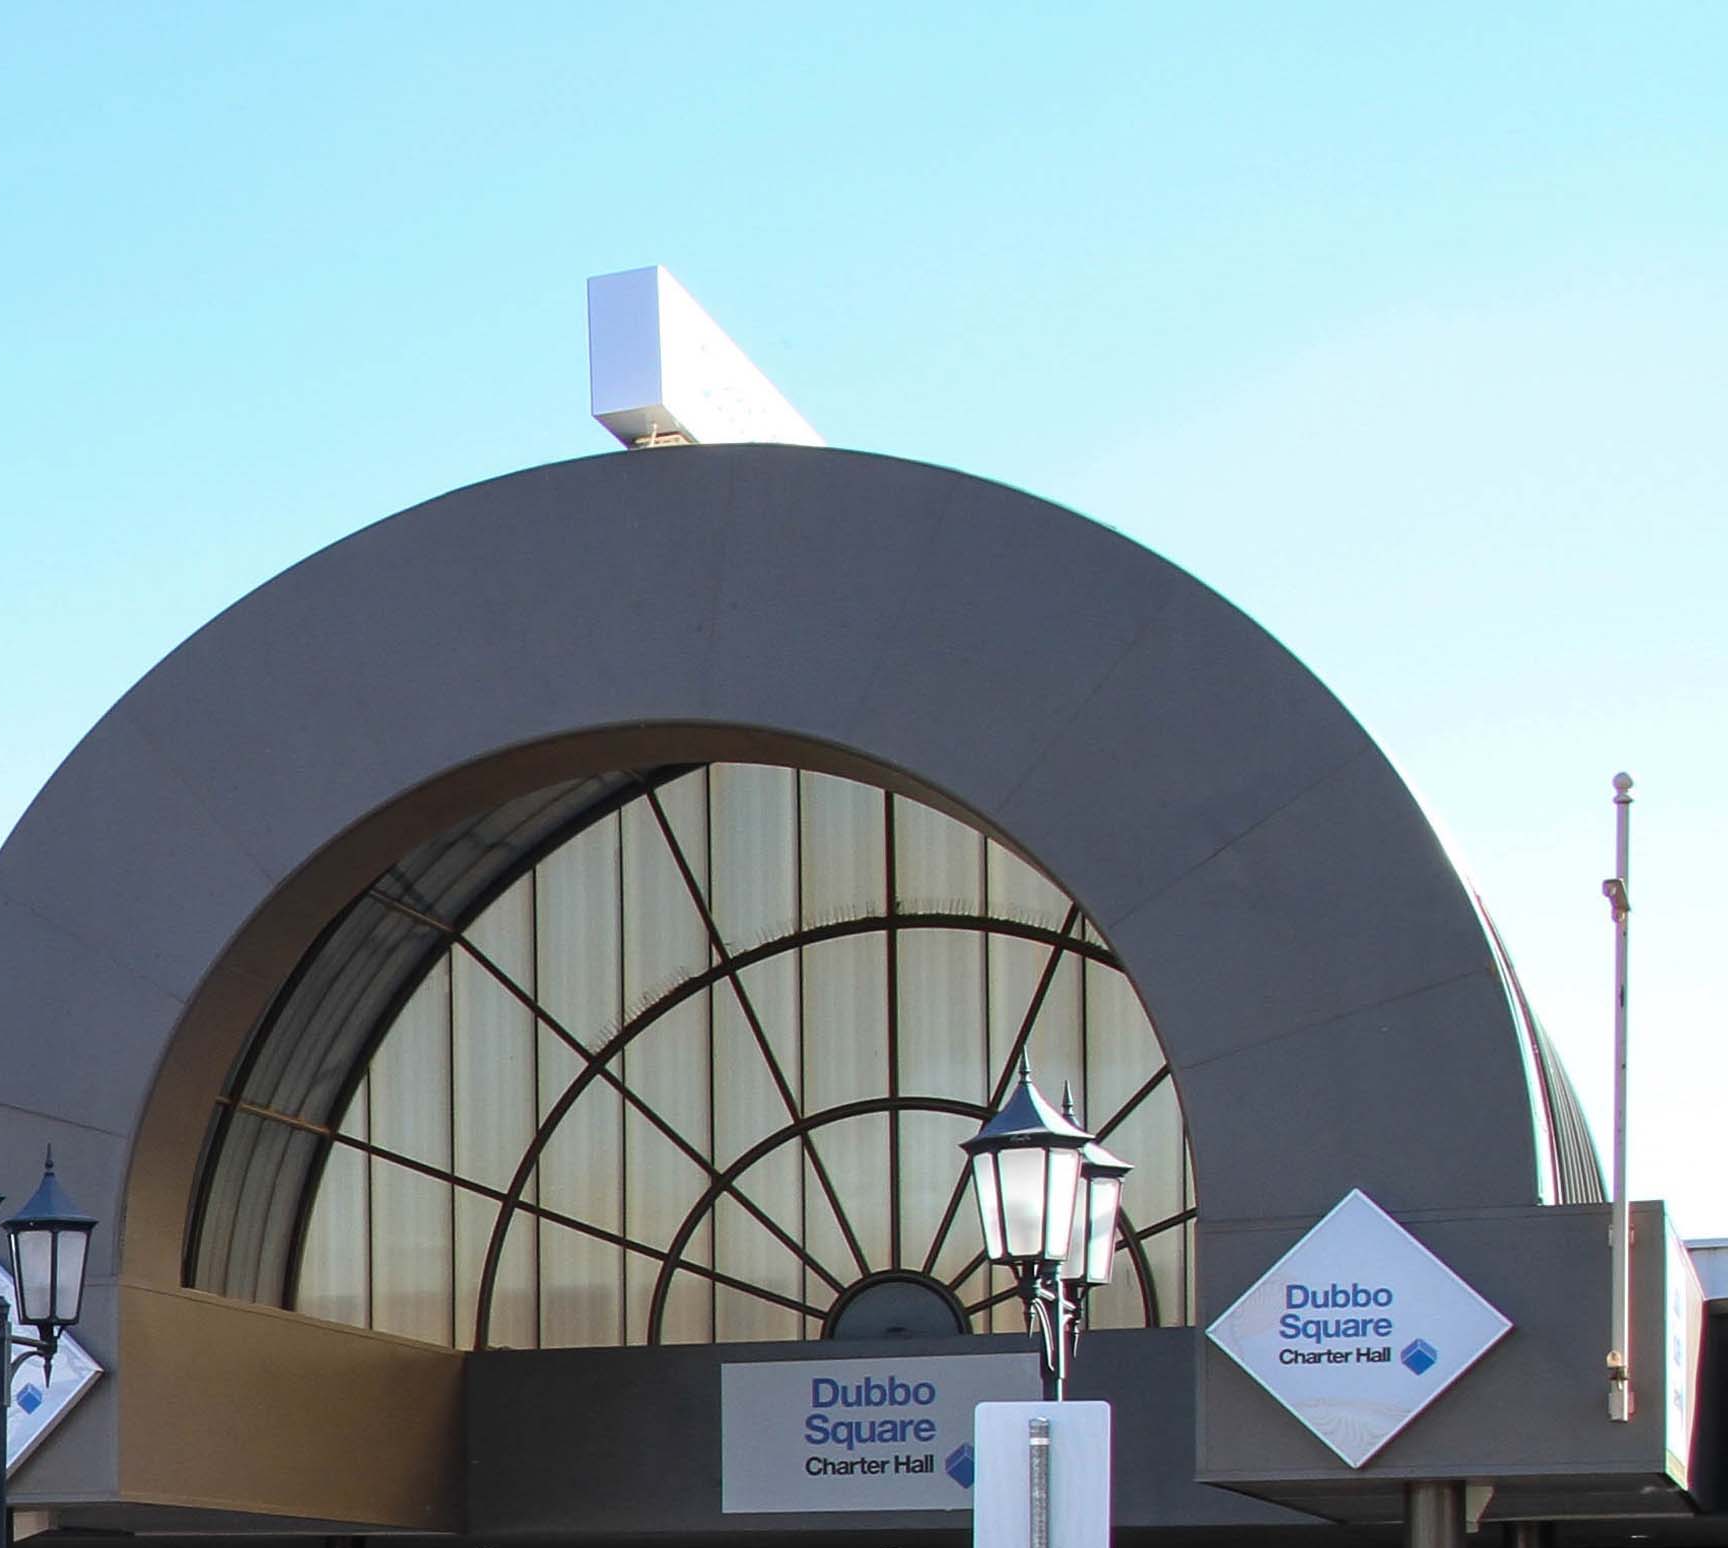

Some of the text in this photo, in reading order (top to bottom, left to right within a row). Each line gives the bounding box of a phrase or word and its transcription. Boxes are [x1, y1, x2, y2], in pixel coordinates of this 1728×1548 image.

[1286, 1283, 1393, 1310] Dubbo
[1279, 1313, 1393, 1345] Square
[1279, 1347, 1392, 1365] Charter Hall
[811, 1376, 936, 1408] Dubbo
[804, 1413, 937, 1450] Square
[805, 1454, 934, 1476] Charter Hall
